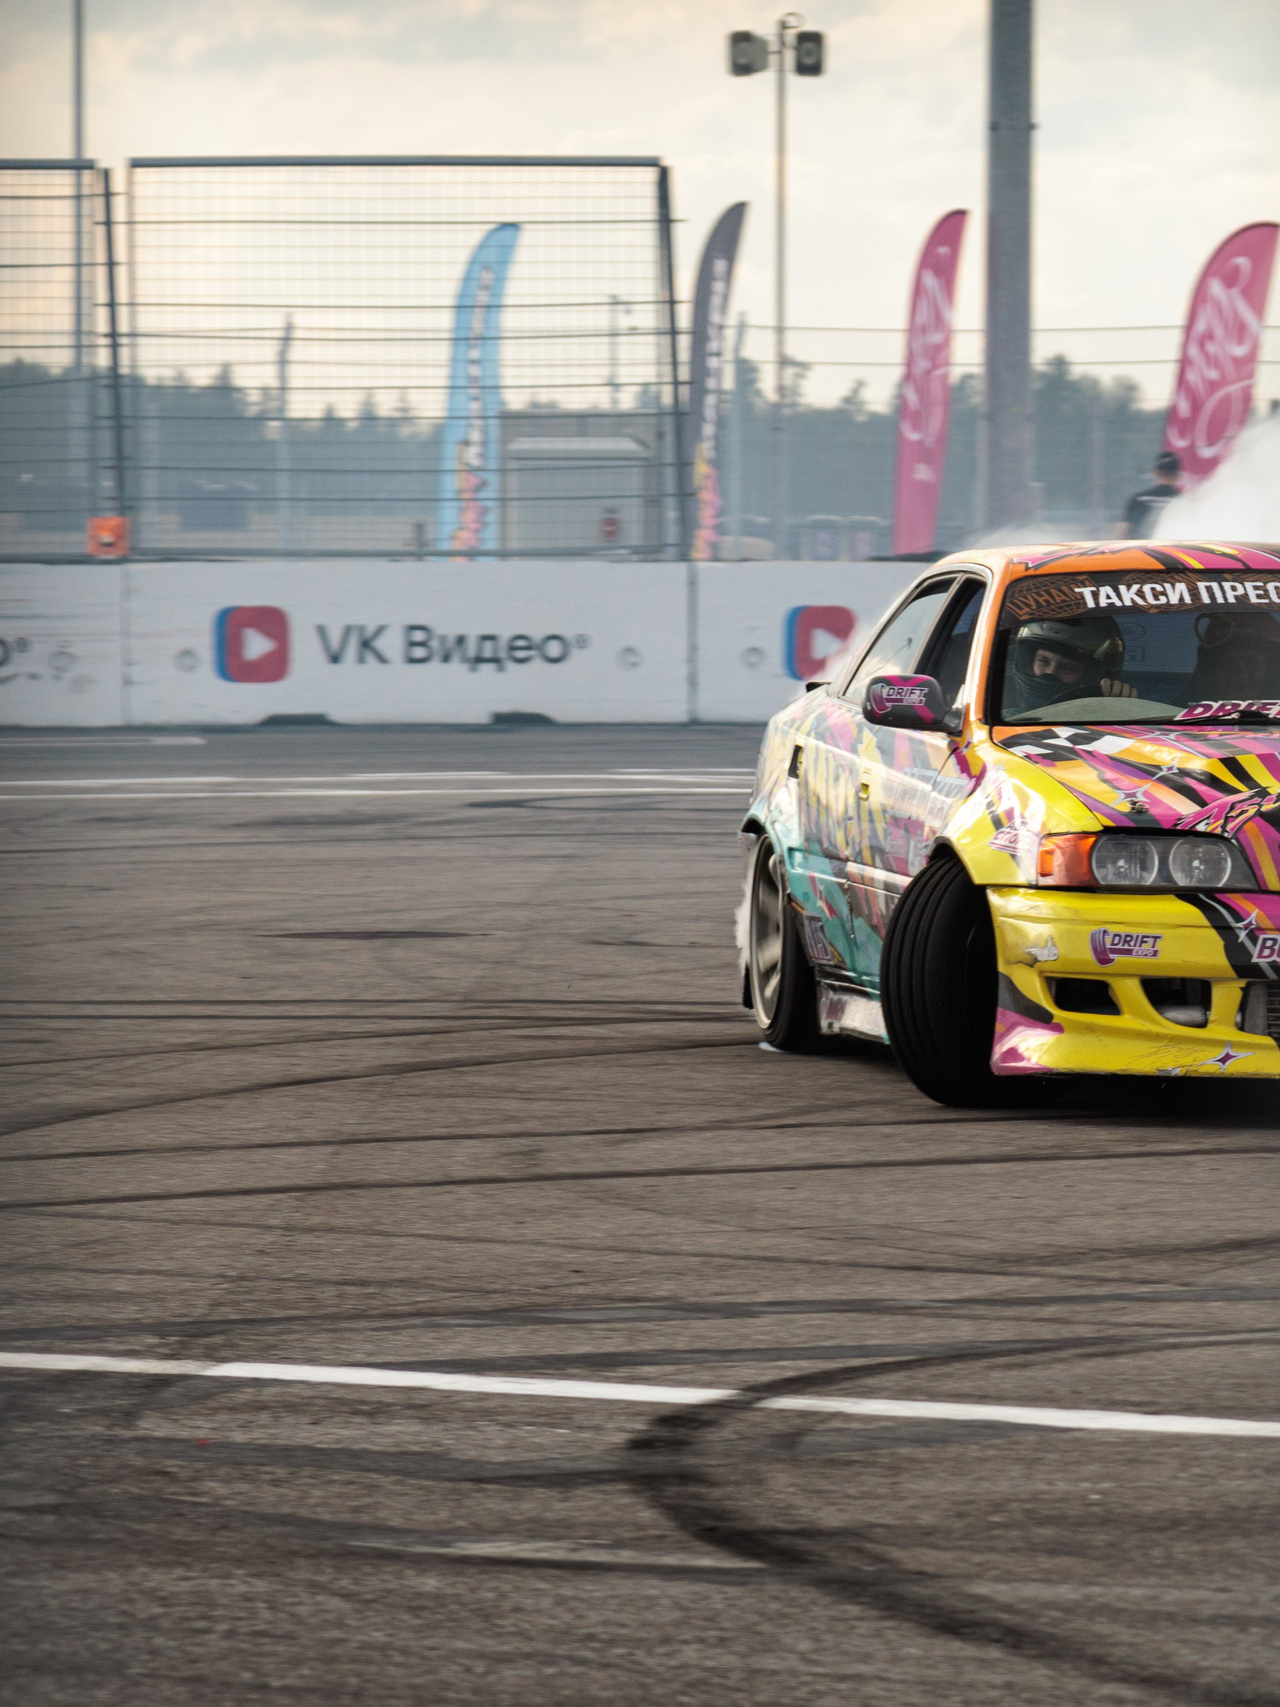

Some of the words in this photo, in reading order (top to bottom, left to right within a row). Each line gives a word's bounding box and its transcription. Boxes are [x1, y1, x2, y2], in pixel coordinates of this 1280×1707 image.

[1074, 582, 1193, 608] ТАКСИ
[315, 624, 391, 664] VK
[886, 687, 927, 698] DRIFT
[1110, 933, 1162, 949] DRIFT
